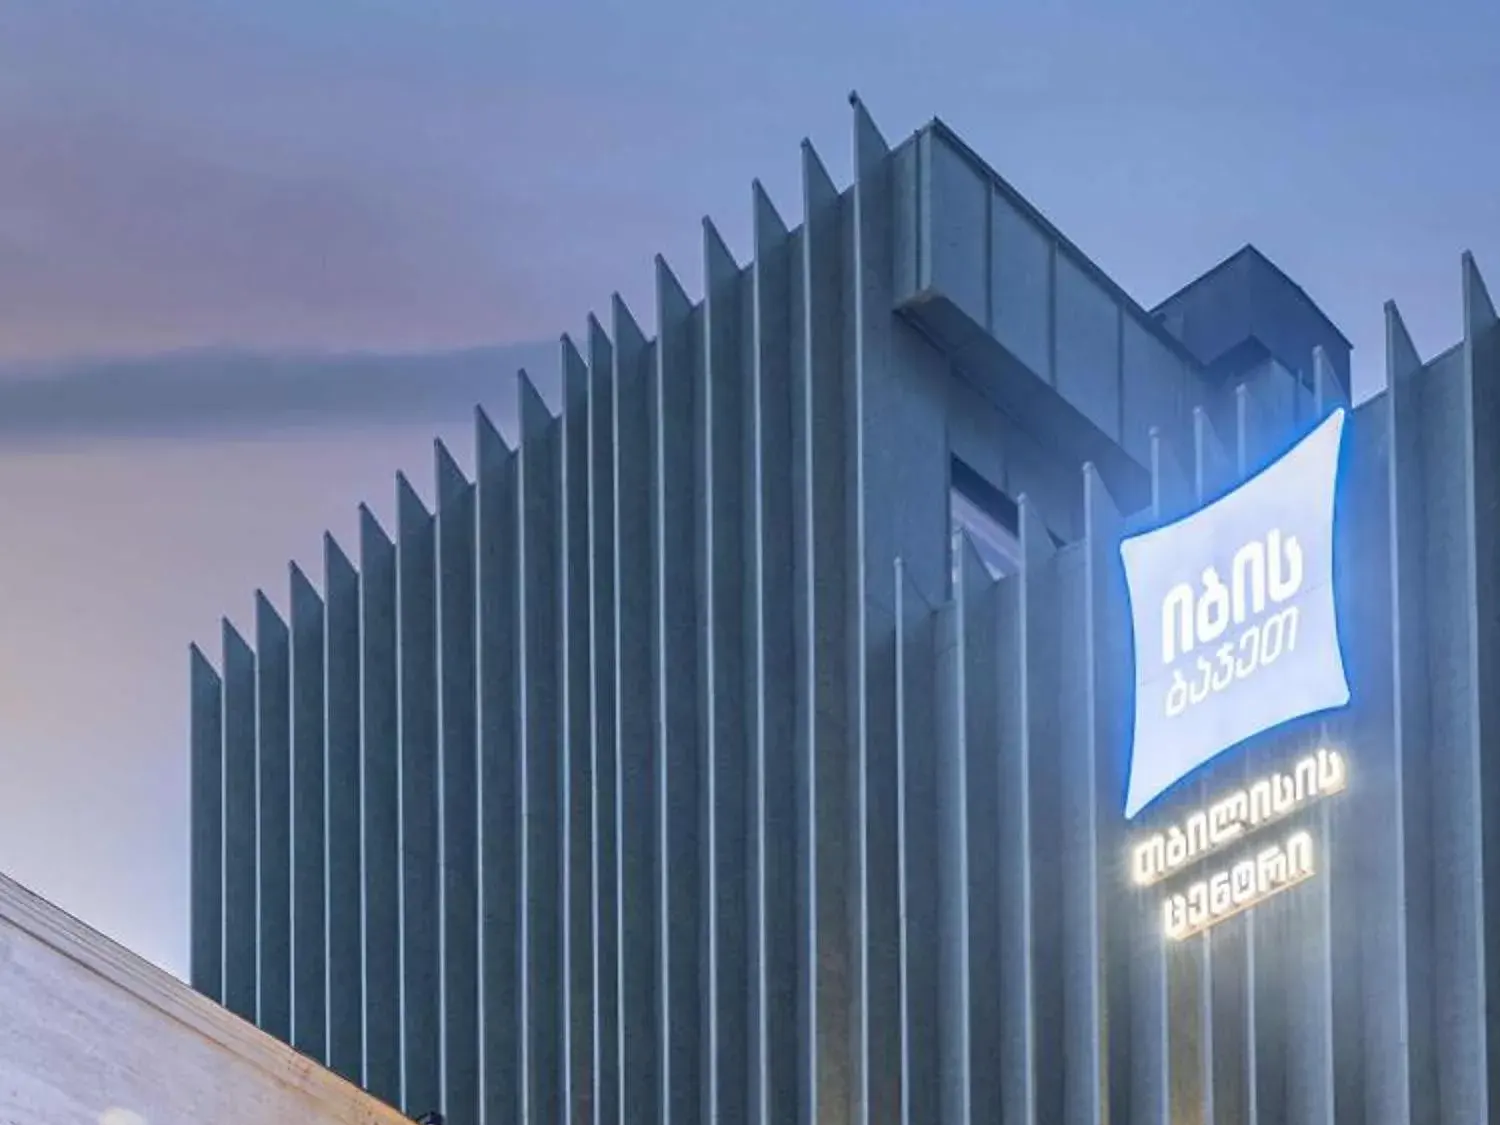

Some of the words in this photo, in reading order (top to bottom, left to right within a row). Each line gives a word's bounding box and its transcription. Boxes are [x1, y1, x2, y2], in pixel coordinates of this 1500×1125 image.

[1162, 528, 1302, 664] იბის
[1133, 748, 1346, 887] თბილისის
[1164, 831, 1315, 940] ცენტრი
